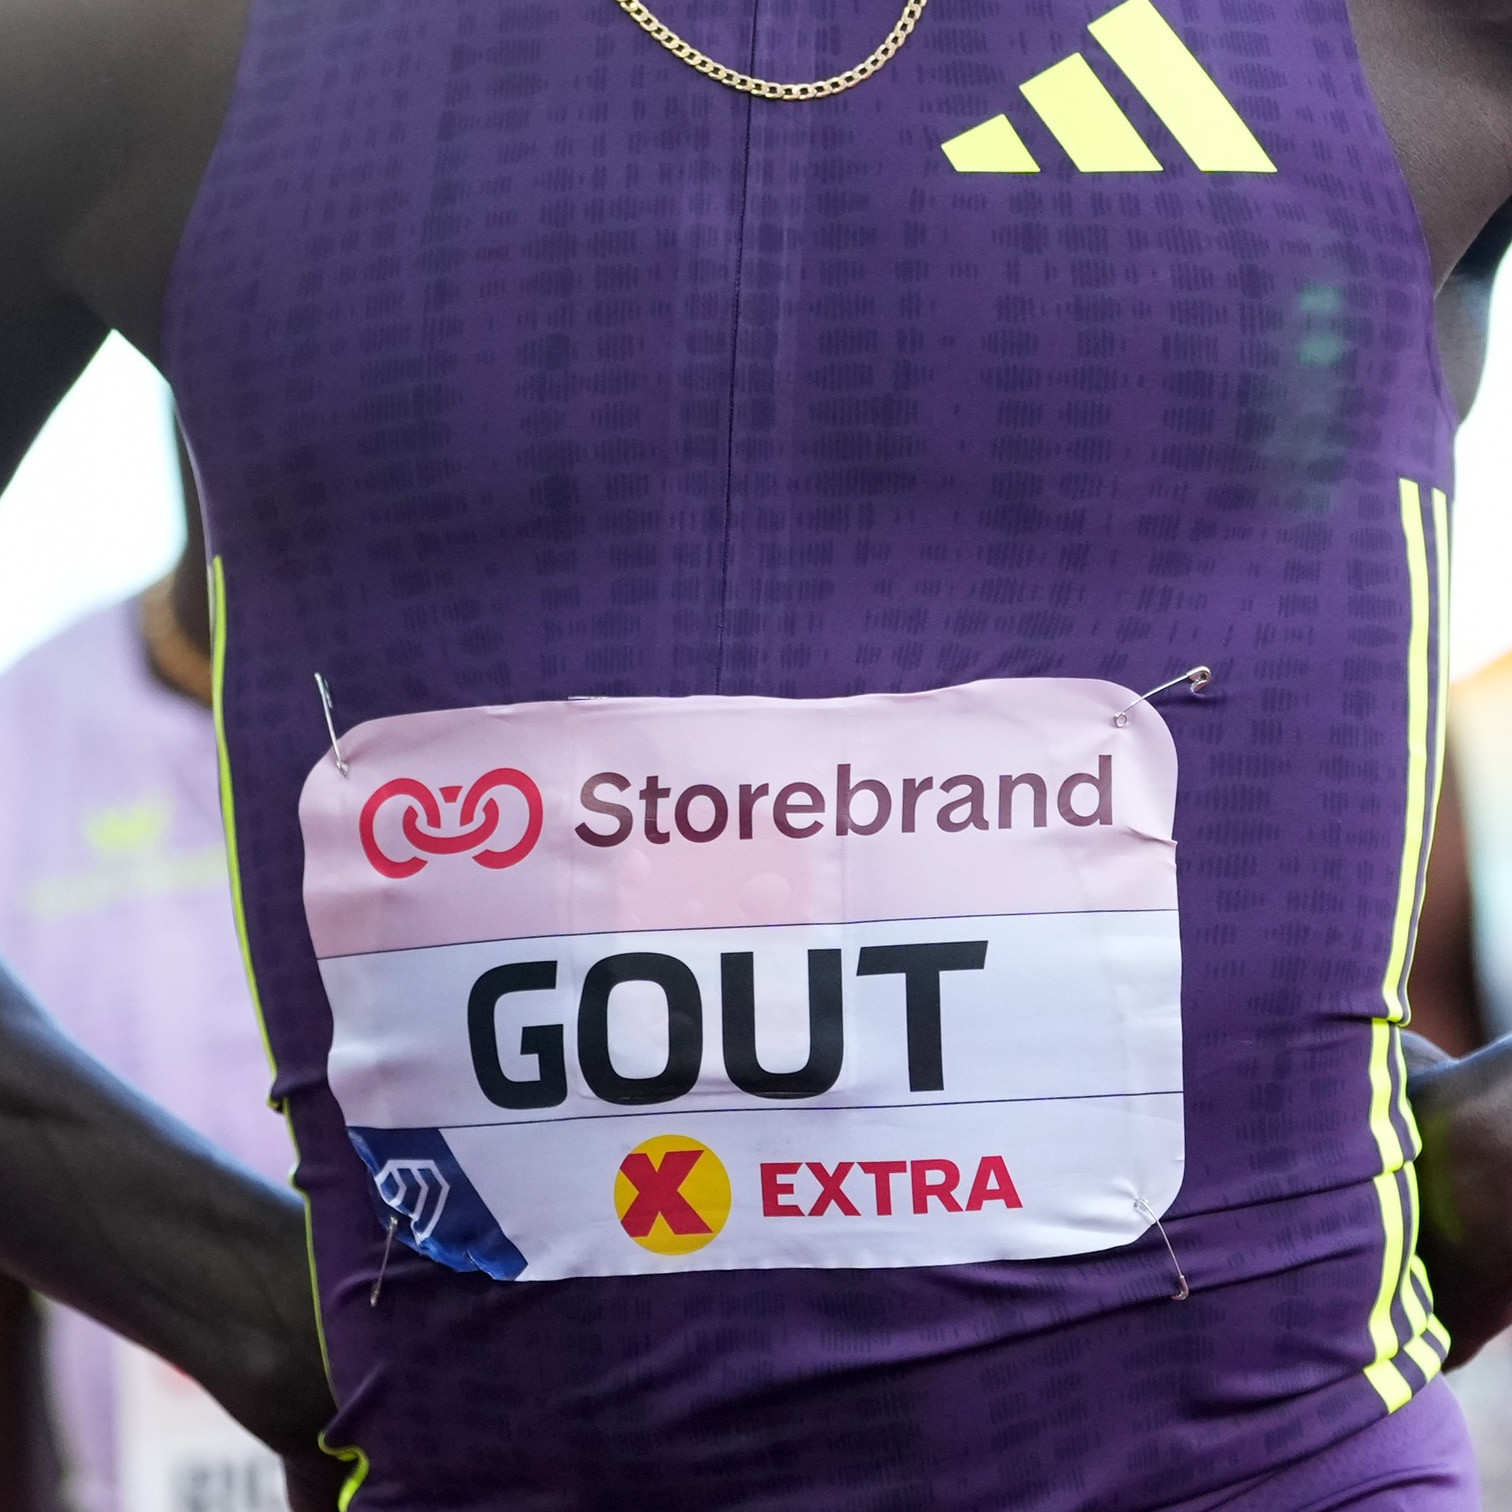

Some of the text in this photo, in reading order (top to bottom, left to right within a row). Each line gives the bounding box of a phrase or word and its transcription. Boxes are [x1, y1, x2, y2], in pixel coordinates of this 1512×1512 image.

[574, 755, 1114, 848] Storebrand
[468, 941, 988, 1110] GOUT
[761, 1155, 1024, 1218] EXTRA
